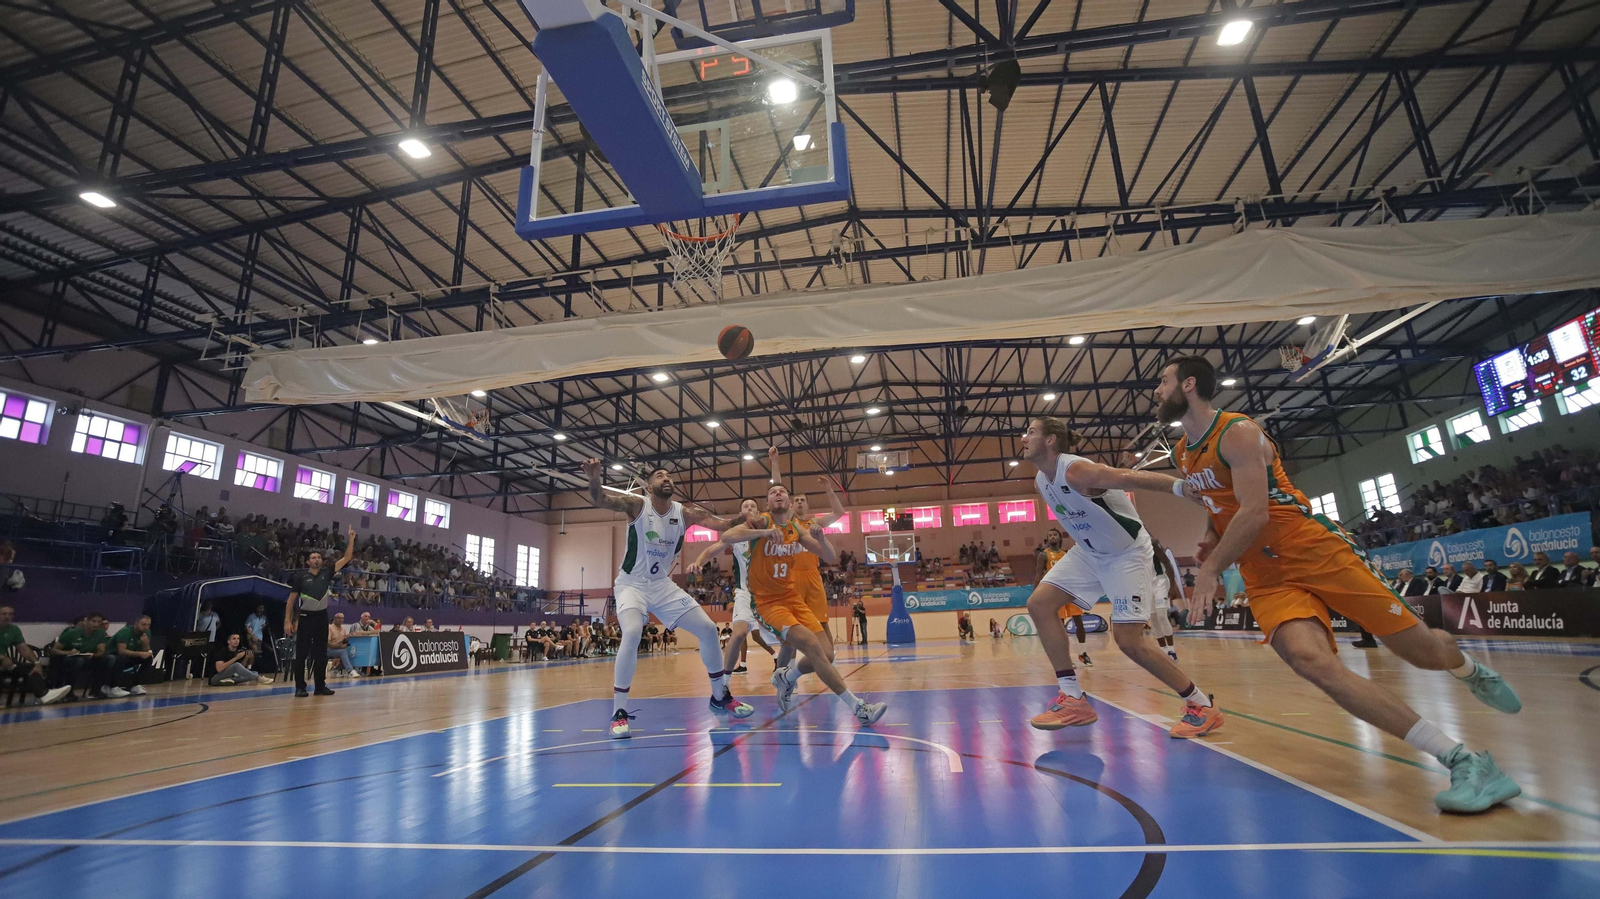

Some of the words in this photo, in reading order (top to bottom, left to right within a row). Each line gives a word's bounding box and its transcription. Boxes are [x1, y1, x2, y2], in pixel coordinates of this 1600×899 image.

[642, 68, 666, 121] SPORT
[664, 117, 691, 170] SYSTEM
[1527, 349, 1550, 366] 1:38
[1570, 366, 1588, 381] 32
[1512, 389, 1527, 403] 36
[884, 512, 896, 522] 24
[1529, 525, 1580, 542] baloncesto
[1447, 539, 1485, 552] baloncesto
[650, 562, 659, 575] 6
[773, 563, 788, 578] 13
[1487, 601, 1519, 614] Junta
[1487, 615, 1500, 628] de
[1503, 613, 1564, 629] Andalucía
[418, 640, 459, 652] baloncesto
[420, 652, 459, 665] andalucía
